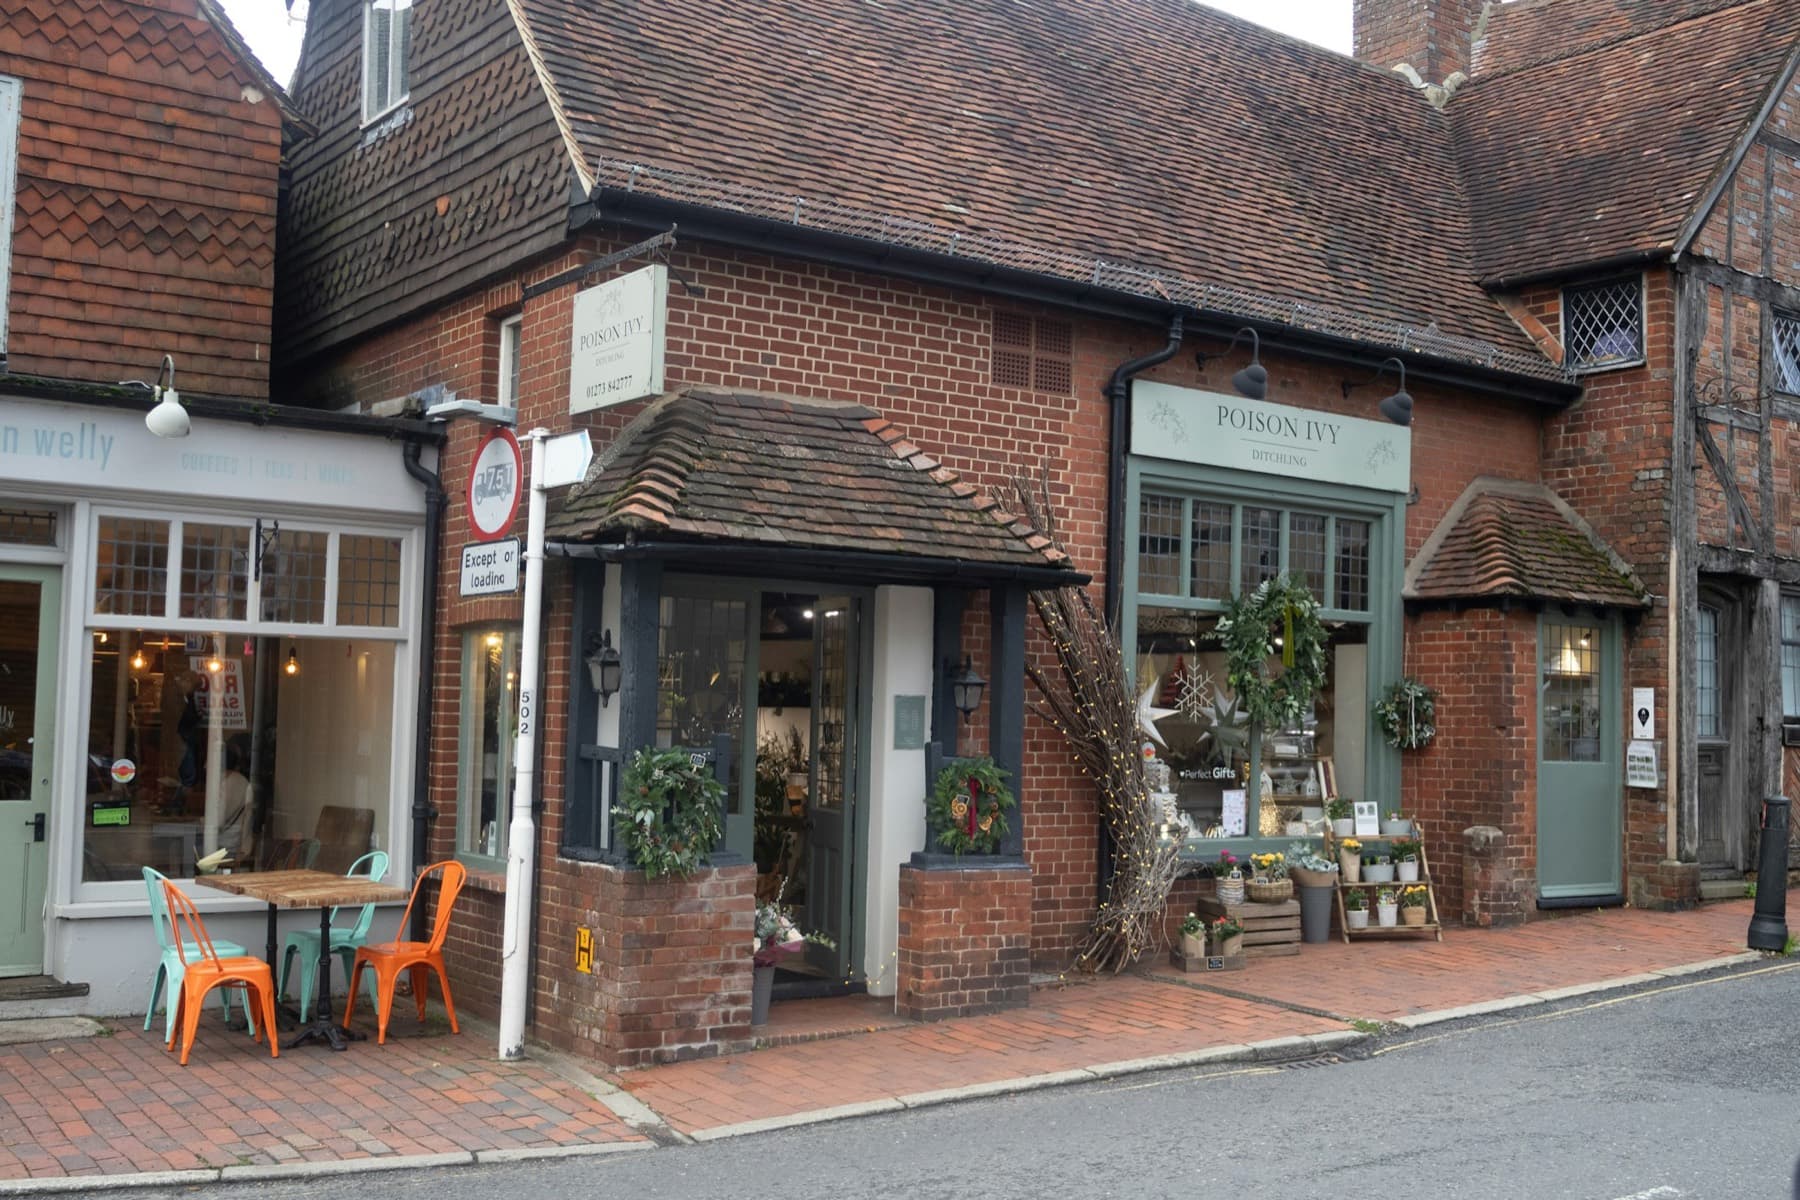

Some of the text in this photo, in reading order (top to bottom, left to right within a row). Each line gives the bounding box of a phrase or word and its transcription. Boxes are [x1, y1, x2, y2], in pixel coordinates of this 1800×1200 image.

[580, 315, 644, 351] POISON IVY
[586, 382, 606, 398] 01273
[1217, 404, 1341, 445] POISON IVY
[33, 421, 115, 472] welly
[1251, 448, 1308, 468] DITCHLING
[465, 550, 514, 569] Except or
[521, 691, 530, 735] 502
[1185, 766, 1236, 779] Perfect Gifts
